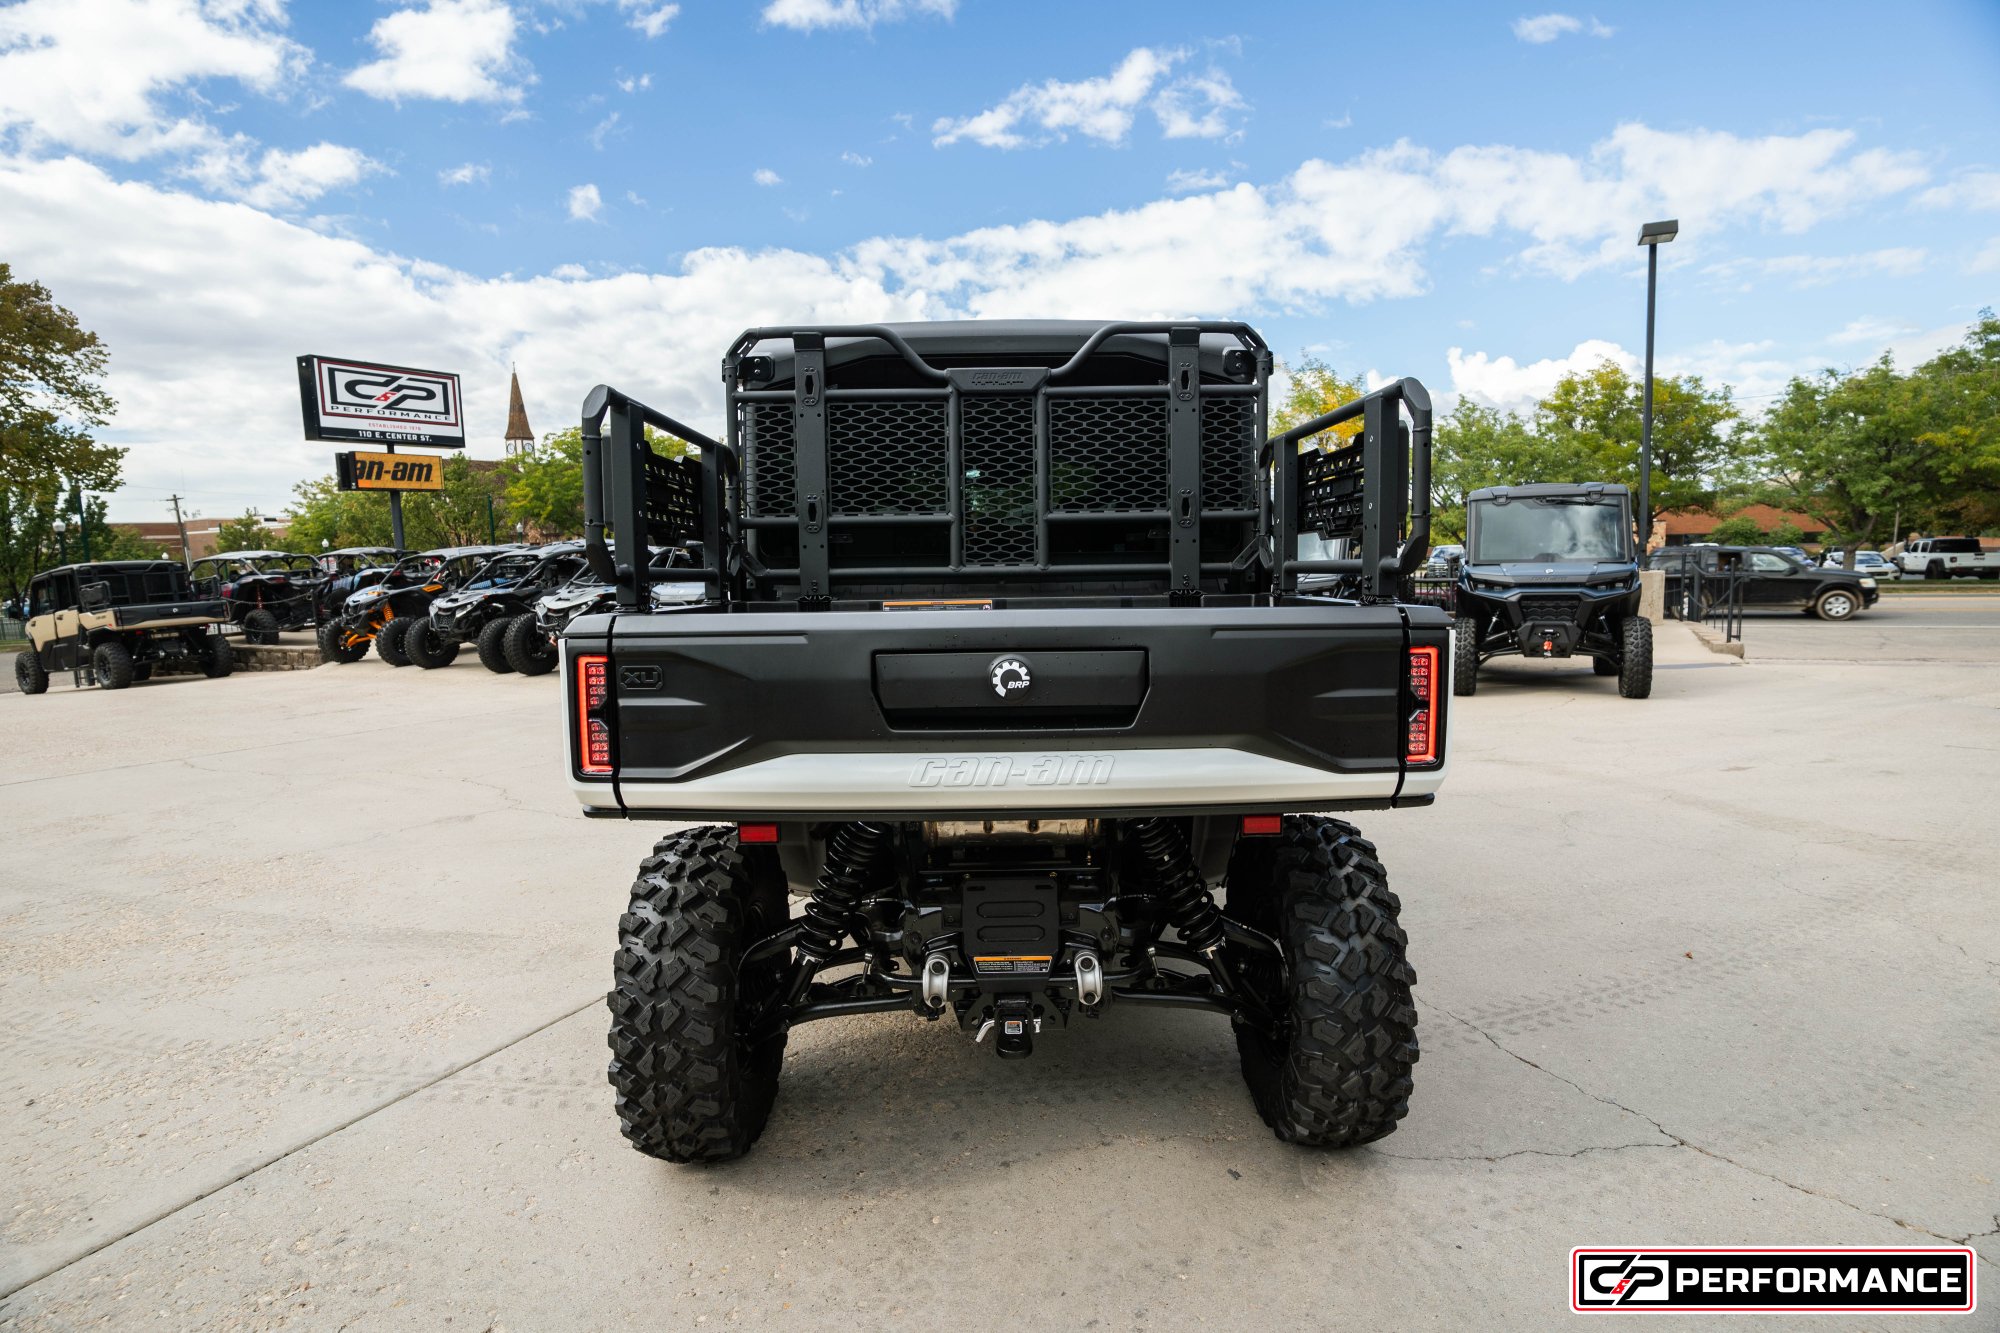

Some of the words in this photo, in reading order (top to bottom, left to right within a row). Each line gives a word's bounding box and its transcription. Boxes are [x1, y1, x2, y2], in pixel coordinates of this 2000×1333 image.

[331, 405, 452, 421] PERFORMANCE
[368, 422, 407, 431] ESTABLISHED
[358, 430, 372, 438] 110
[375, 431, 383, 439] E.
[386, 432, 418, 441] CENTER
[420, 434, 433, 442] ST.
[355, 459, 433, 482] an-am
[1007, 680, 1030, 689] BRP
[908, 754, 1115, 787] can-am
